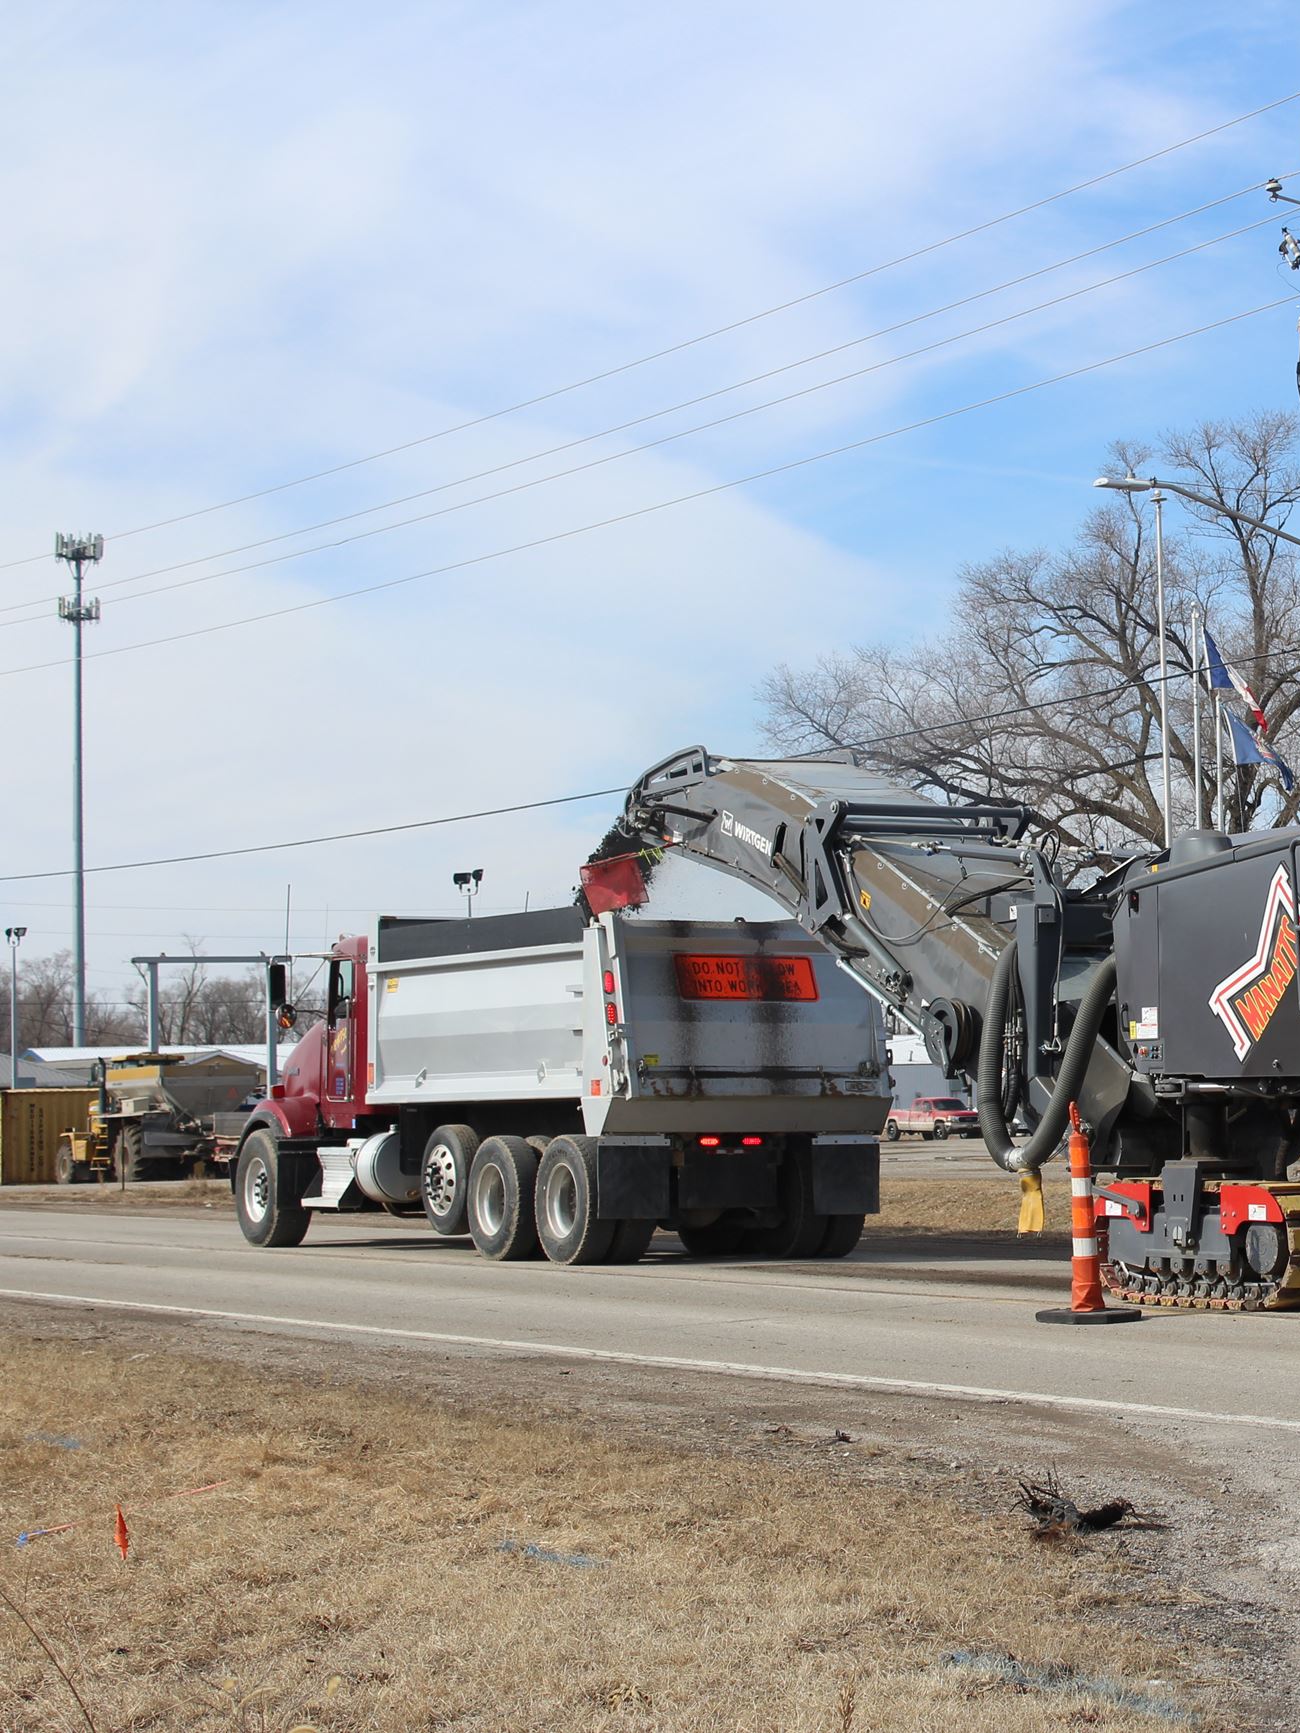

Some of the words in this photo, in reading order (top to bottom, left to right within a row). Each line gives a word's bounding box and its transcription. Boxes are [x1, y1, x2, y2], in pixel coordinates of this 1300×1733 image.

[734, 820, 772, 857] WIRTGEN
[692, 961, 710, 976] DO
[715, 961, 741, 977] NOT
[694, 979, 723, 993] INTO
